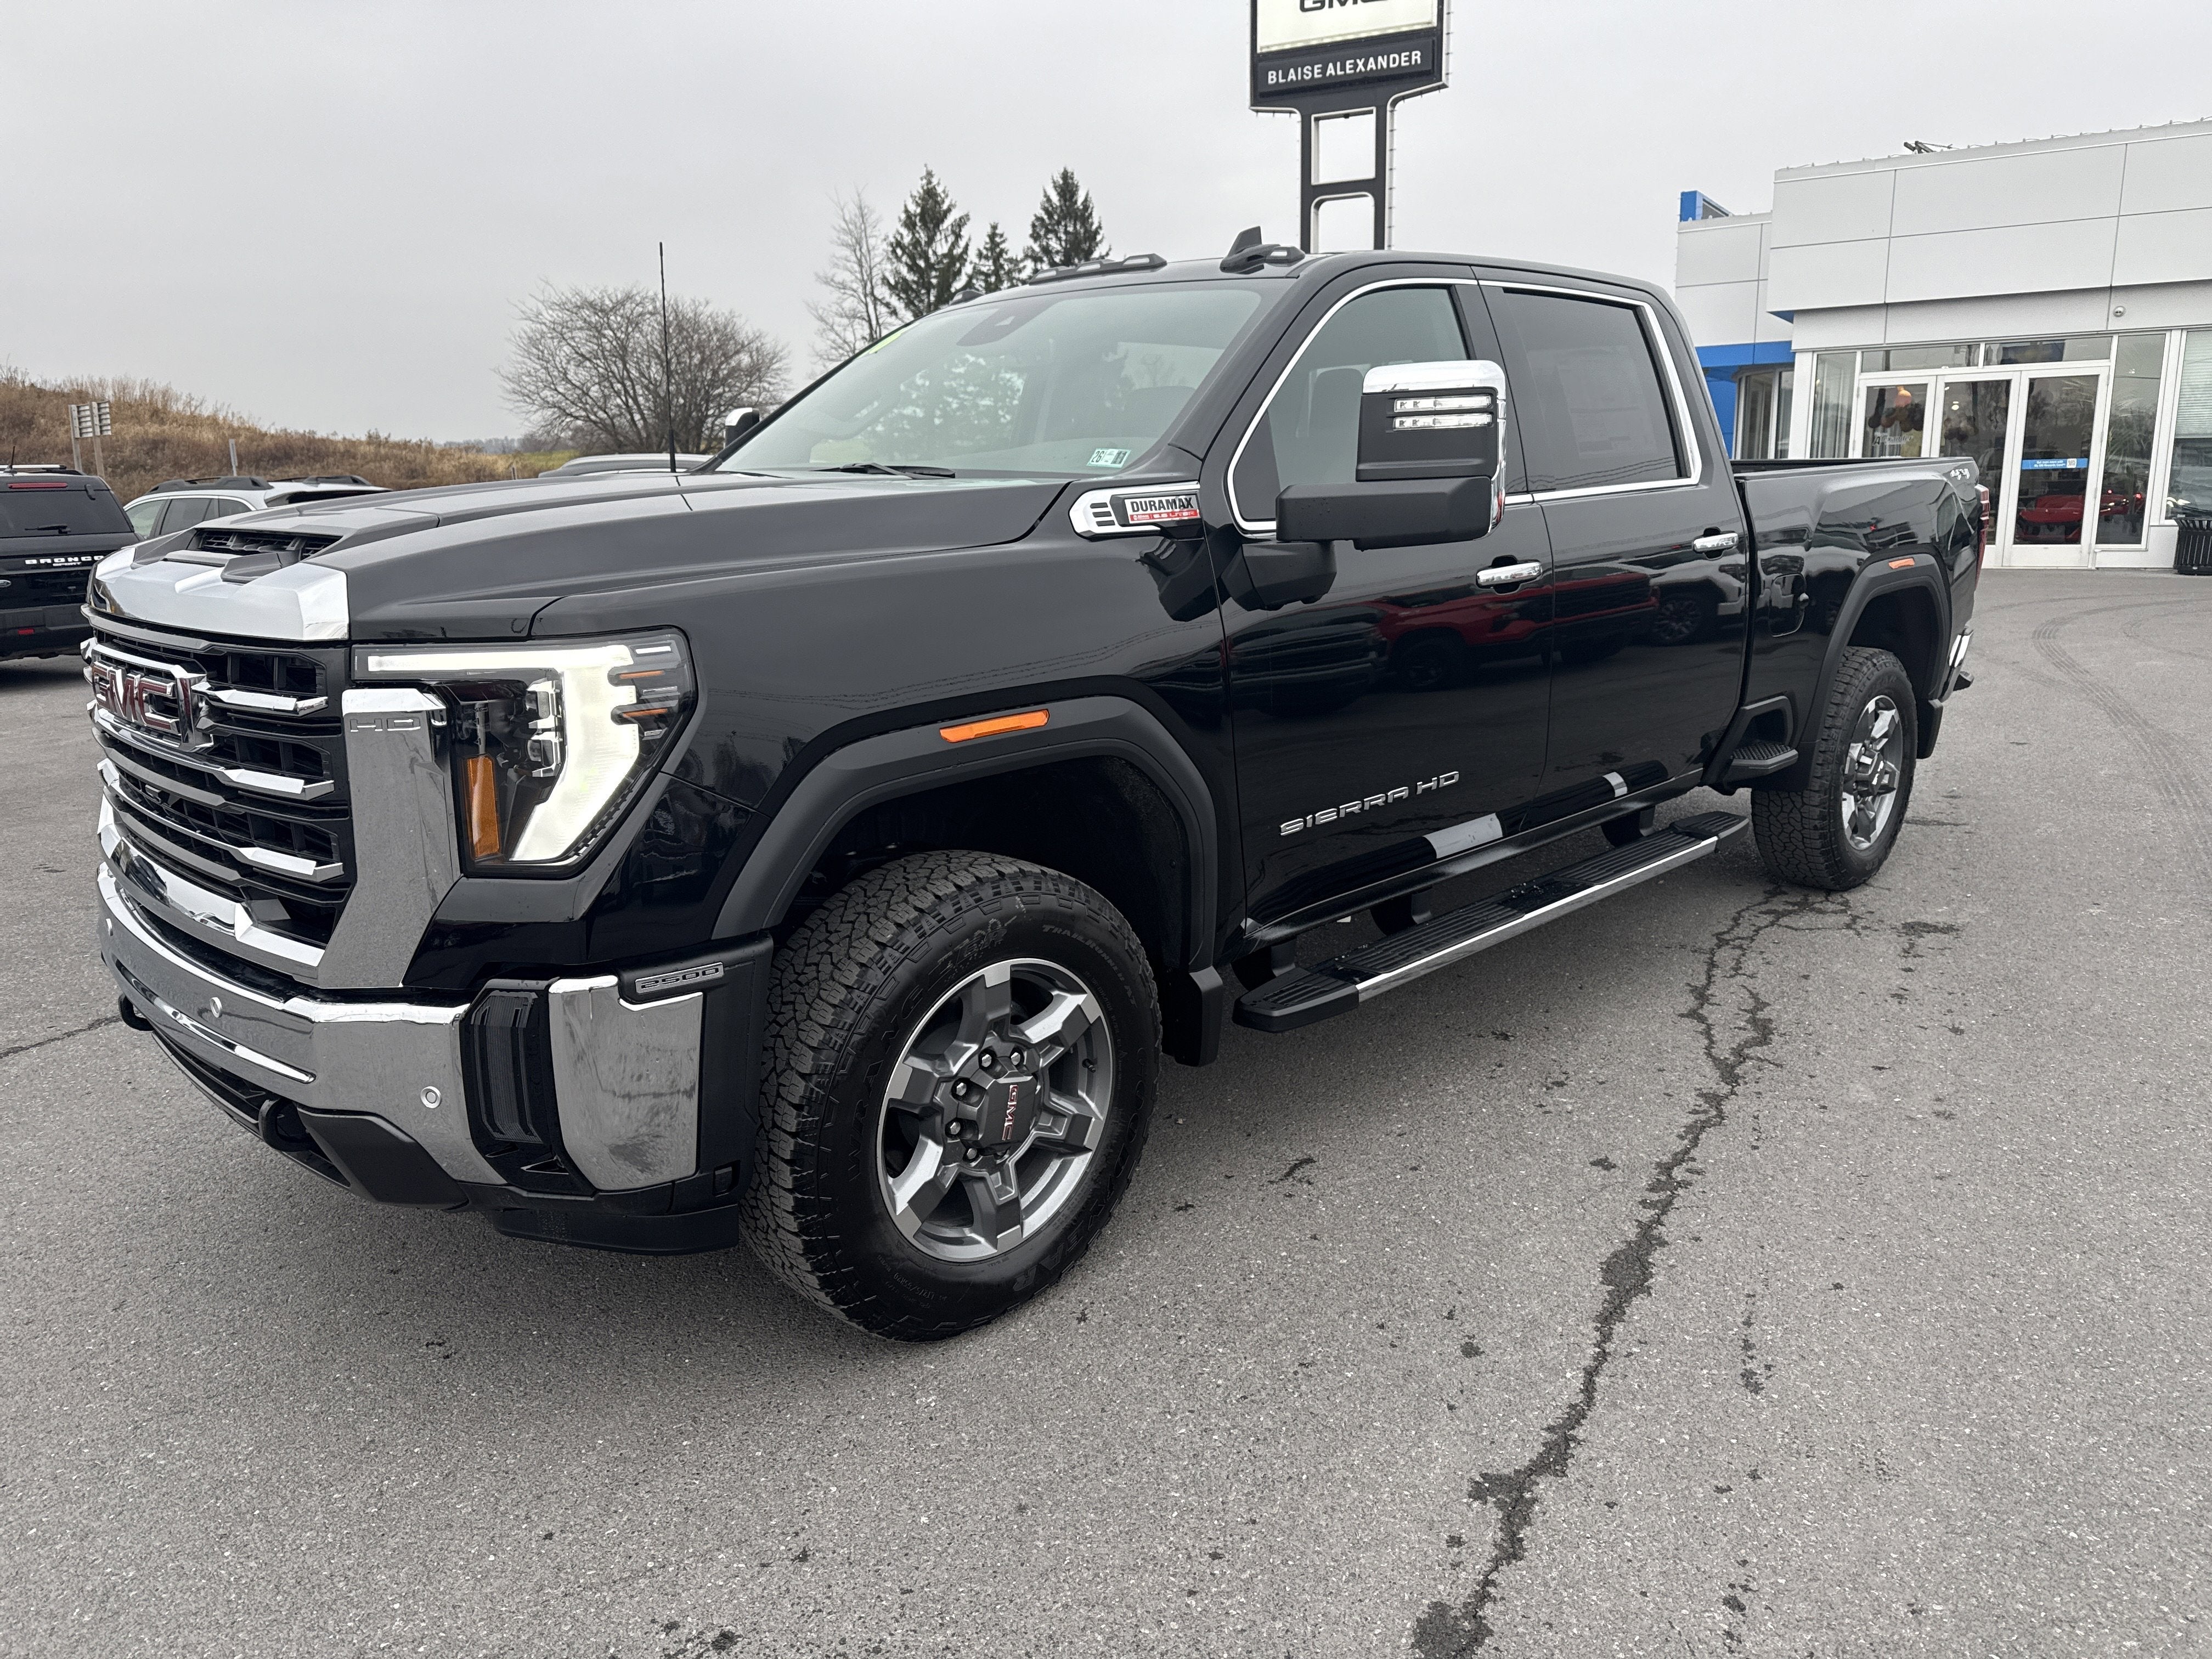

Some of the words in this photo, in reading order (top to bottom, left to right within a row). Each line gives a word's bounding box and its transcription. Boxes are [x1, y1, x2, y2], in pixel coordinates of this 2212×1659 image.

[1268, 64, 1322, 84] BLAISE
[1326, 50, 1421, 76] ALEXANDER
[1091, 450, 1105, 463] 26
[1130, 497, 1194, 512] DURAMAX
[25, 555, 104, 565] BRONCO
[92, 661, 182, 736] GMC
[350, 716, 421, 732] HD
[1280, 787, 1409, 836] SIERRA
[1417, 771, 1459, 795] HD
[1042, 924, 1125, 981] TRAILRUNNER
[640, 967, 719, 989] 2500
[1002, 1085, 1019, 1141] GMC
